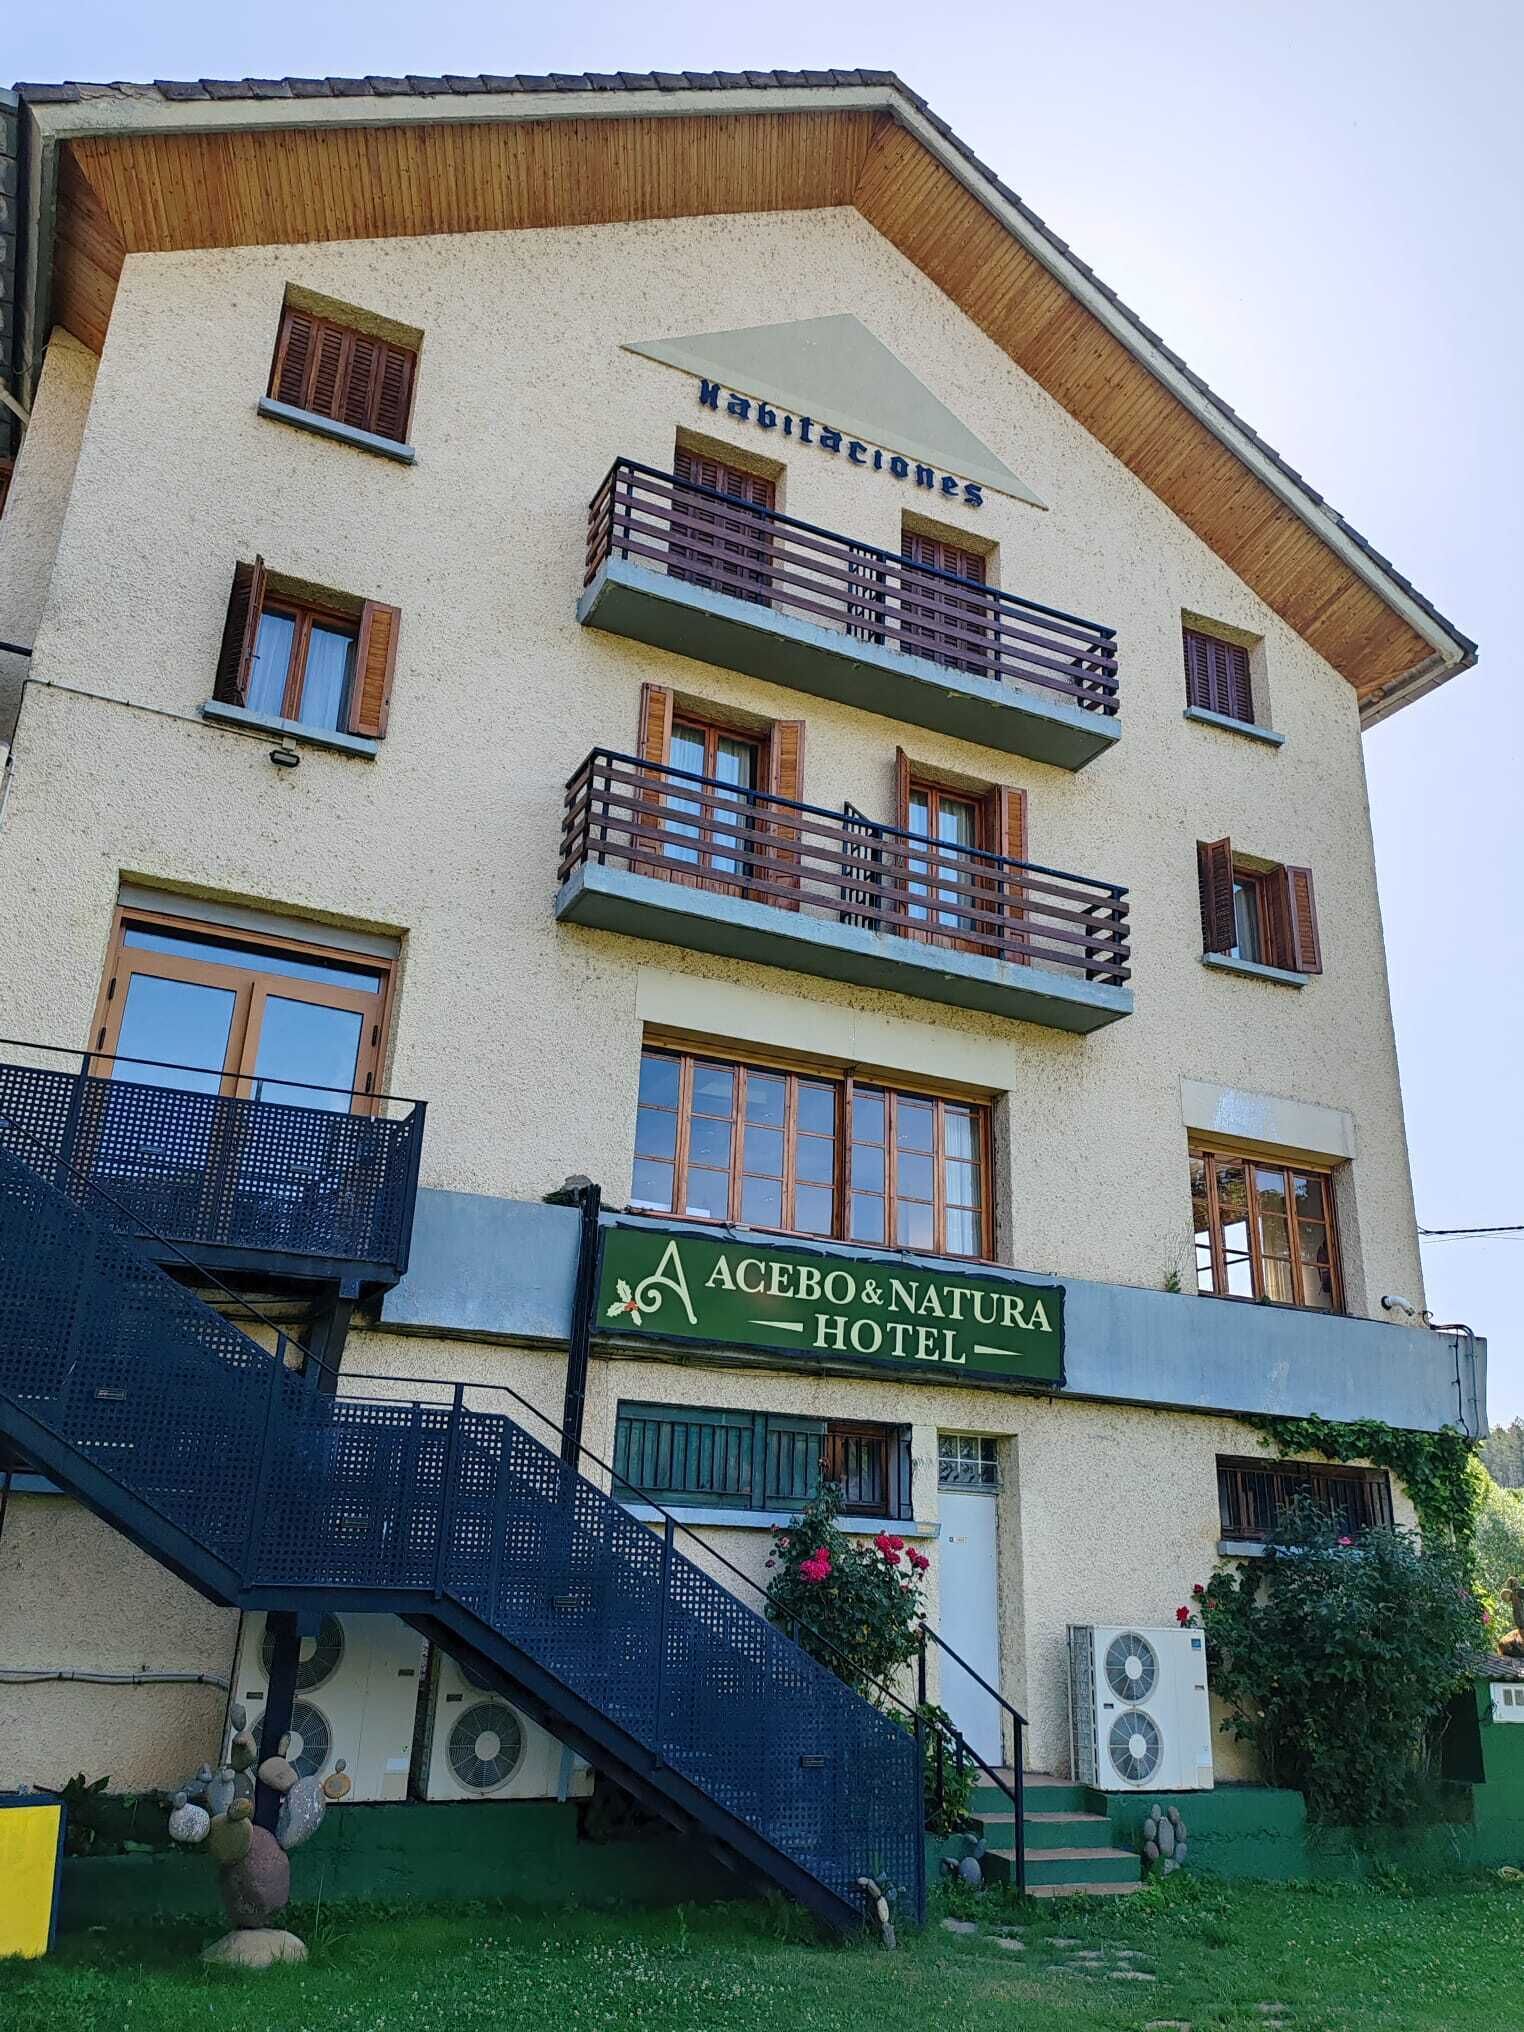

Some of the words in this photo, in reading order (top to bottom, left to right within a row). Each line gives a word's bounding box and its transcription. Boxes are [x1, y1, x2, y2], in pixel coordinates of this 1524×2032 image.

[699, 378, 984, 507] Habitaciones
[705, 1255, 856, 1304] ACEBO
[888, 1279, 1052, 1332] NATURA
[813, 1314, 966, 1364] HOTEL
